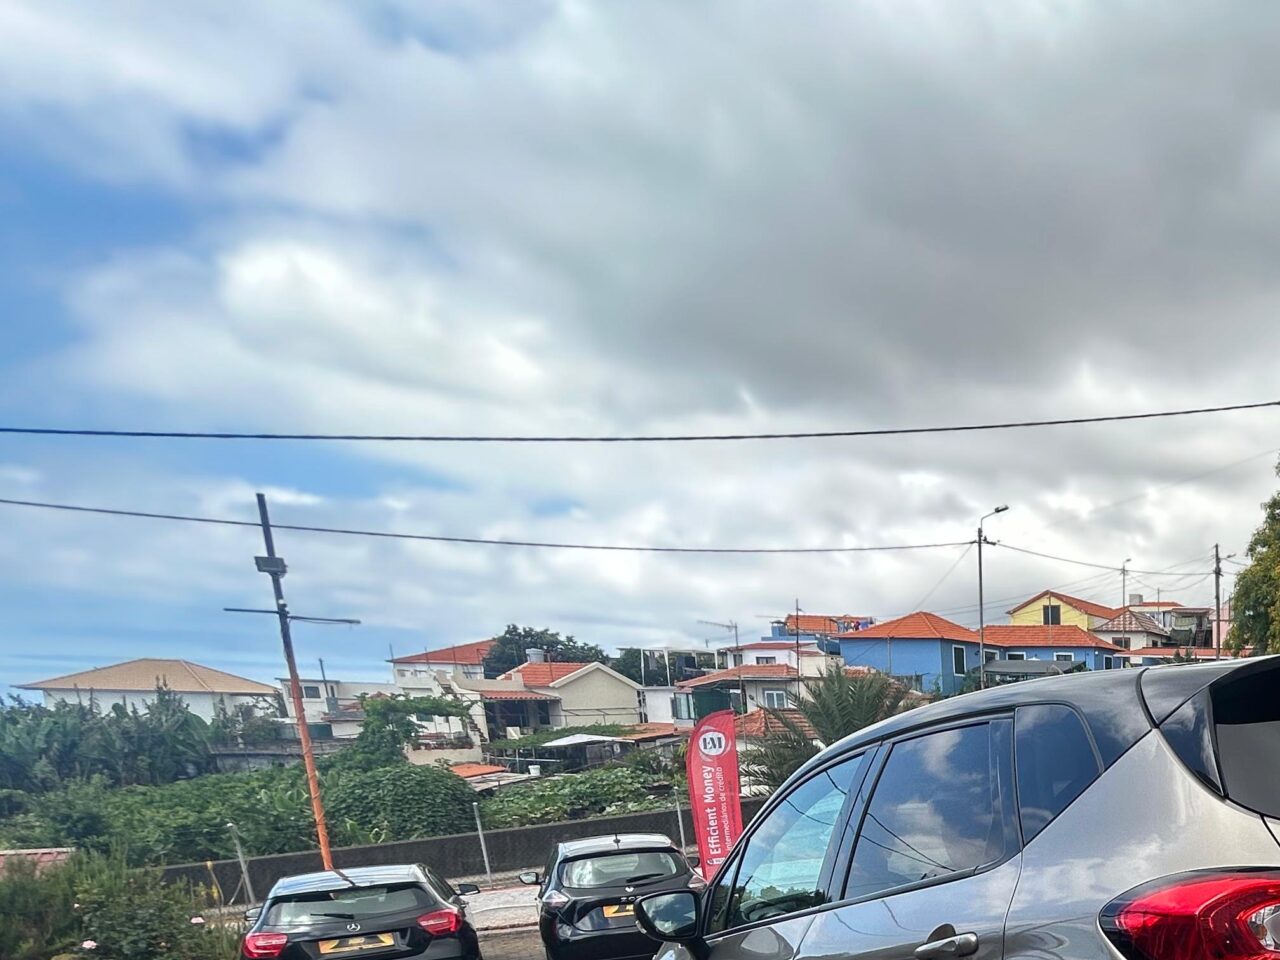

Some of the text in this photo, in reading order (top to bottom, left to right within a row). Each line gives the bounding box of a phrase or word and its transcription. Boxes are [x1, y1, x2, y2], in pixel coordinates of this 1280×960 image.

[702, 766, 716, 803] Money
[719, 793, 727, 802] de
[705, 807, 721, 855] Efficient
